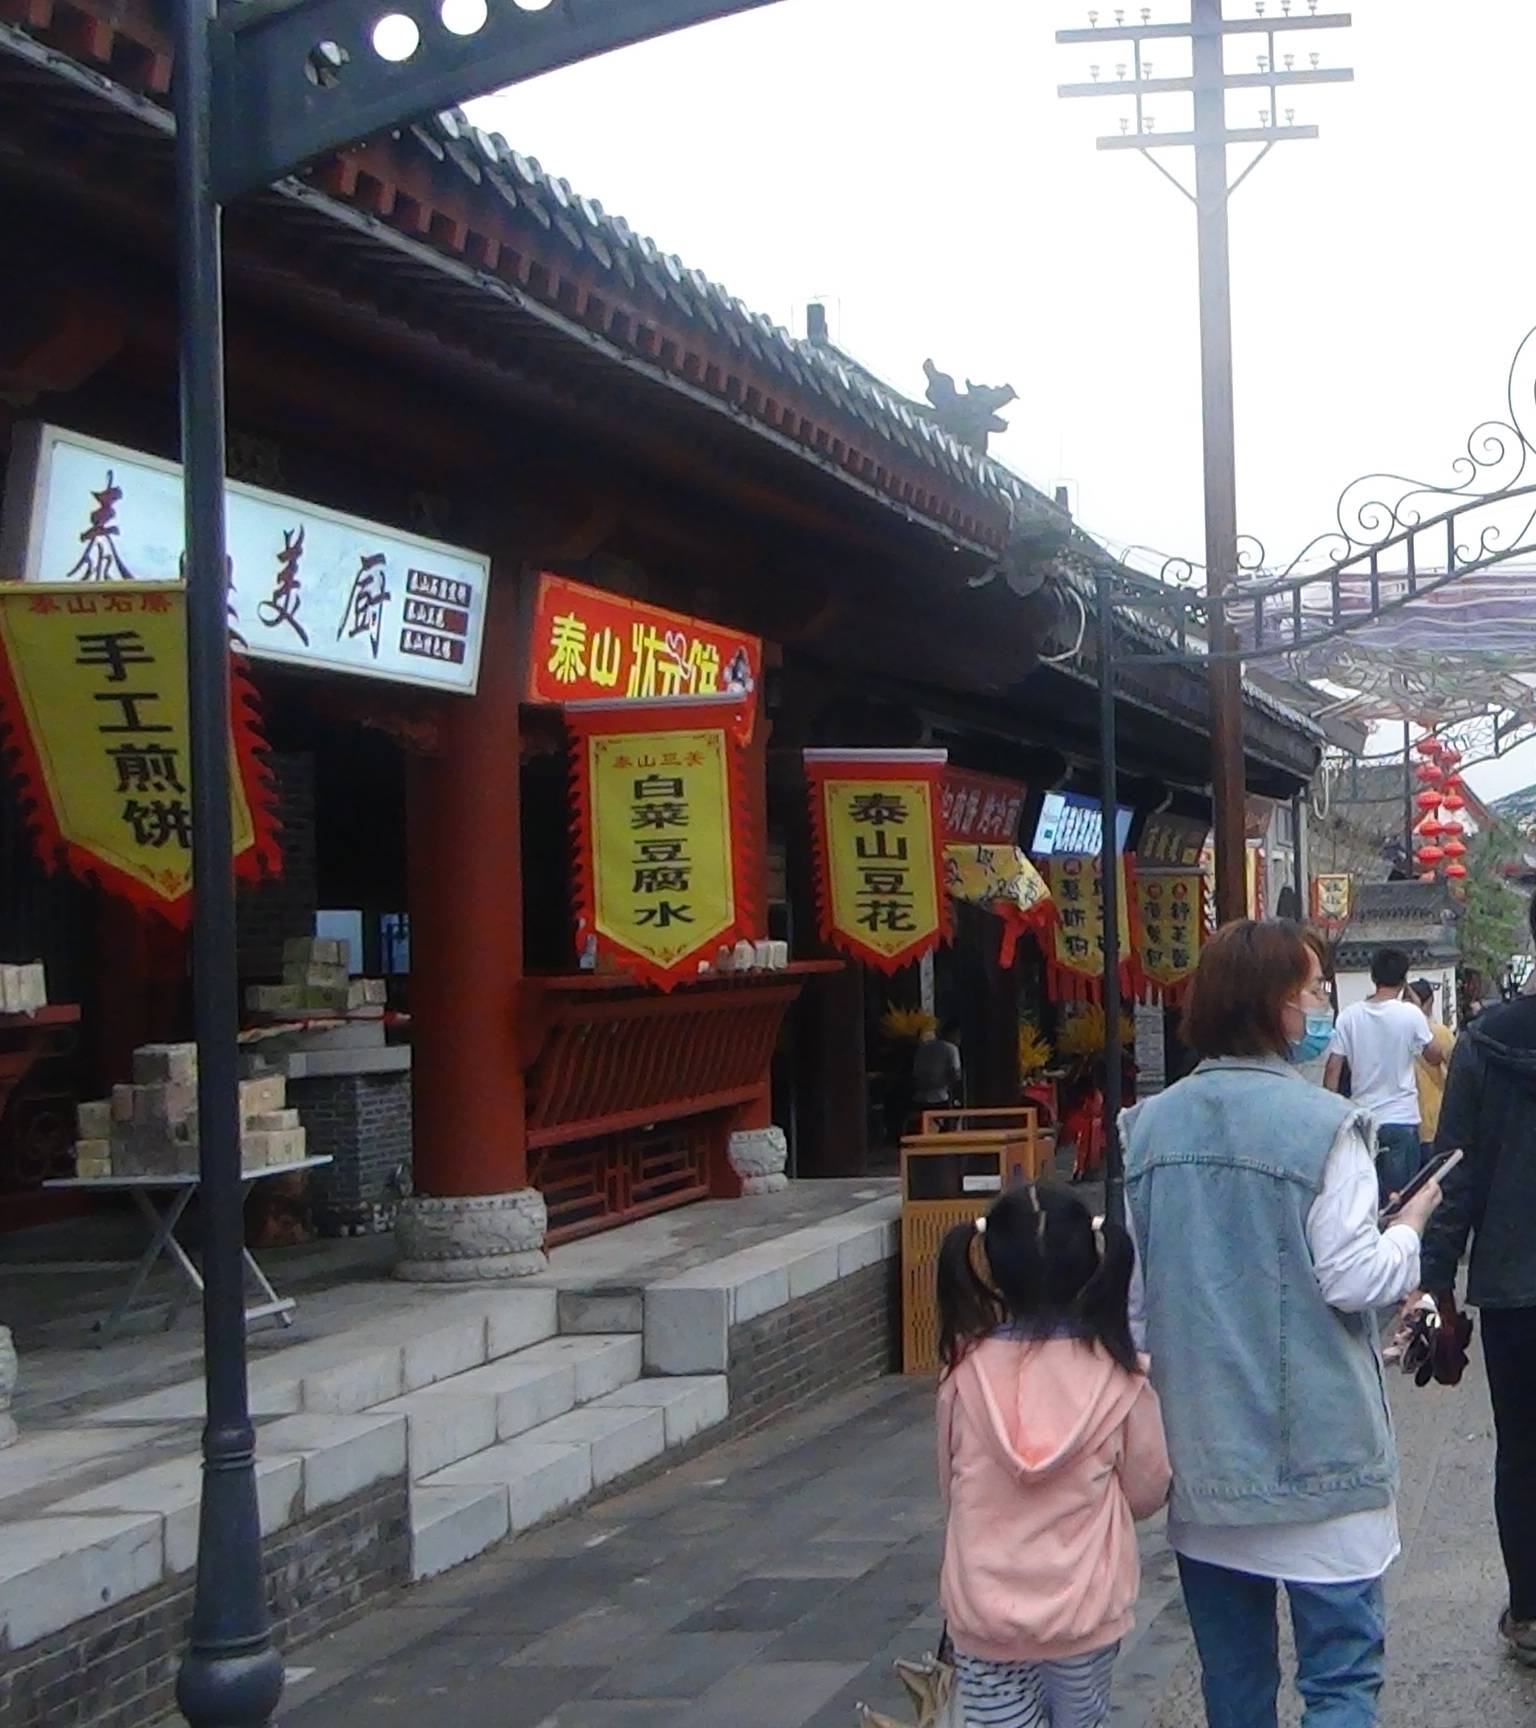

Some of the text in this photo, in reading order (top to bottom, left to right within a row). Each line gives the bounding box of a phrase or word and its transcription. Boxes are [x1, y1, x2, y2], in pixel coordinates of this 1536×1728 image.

[66, 469, 391, 659] 泰美厨
[75, 631, 195, 848] 手工煎饼
[631, 773, 695, 928] 白菜豆腐水
[848, 792, 917, 932] 泰山豆花
